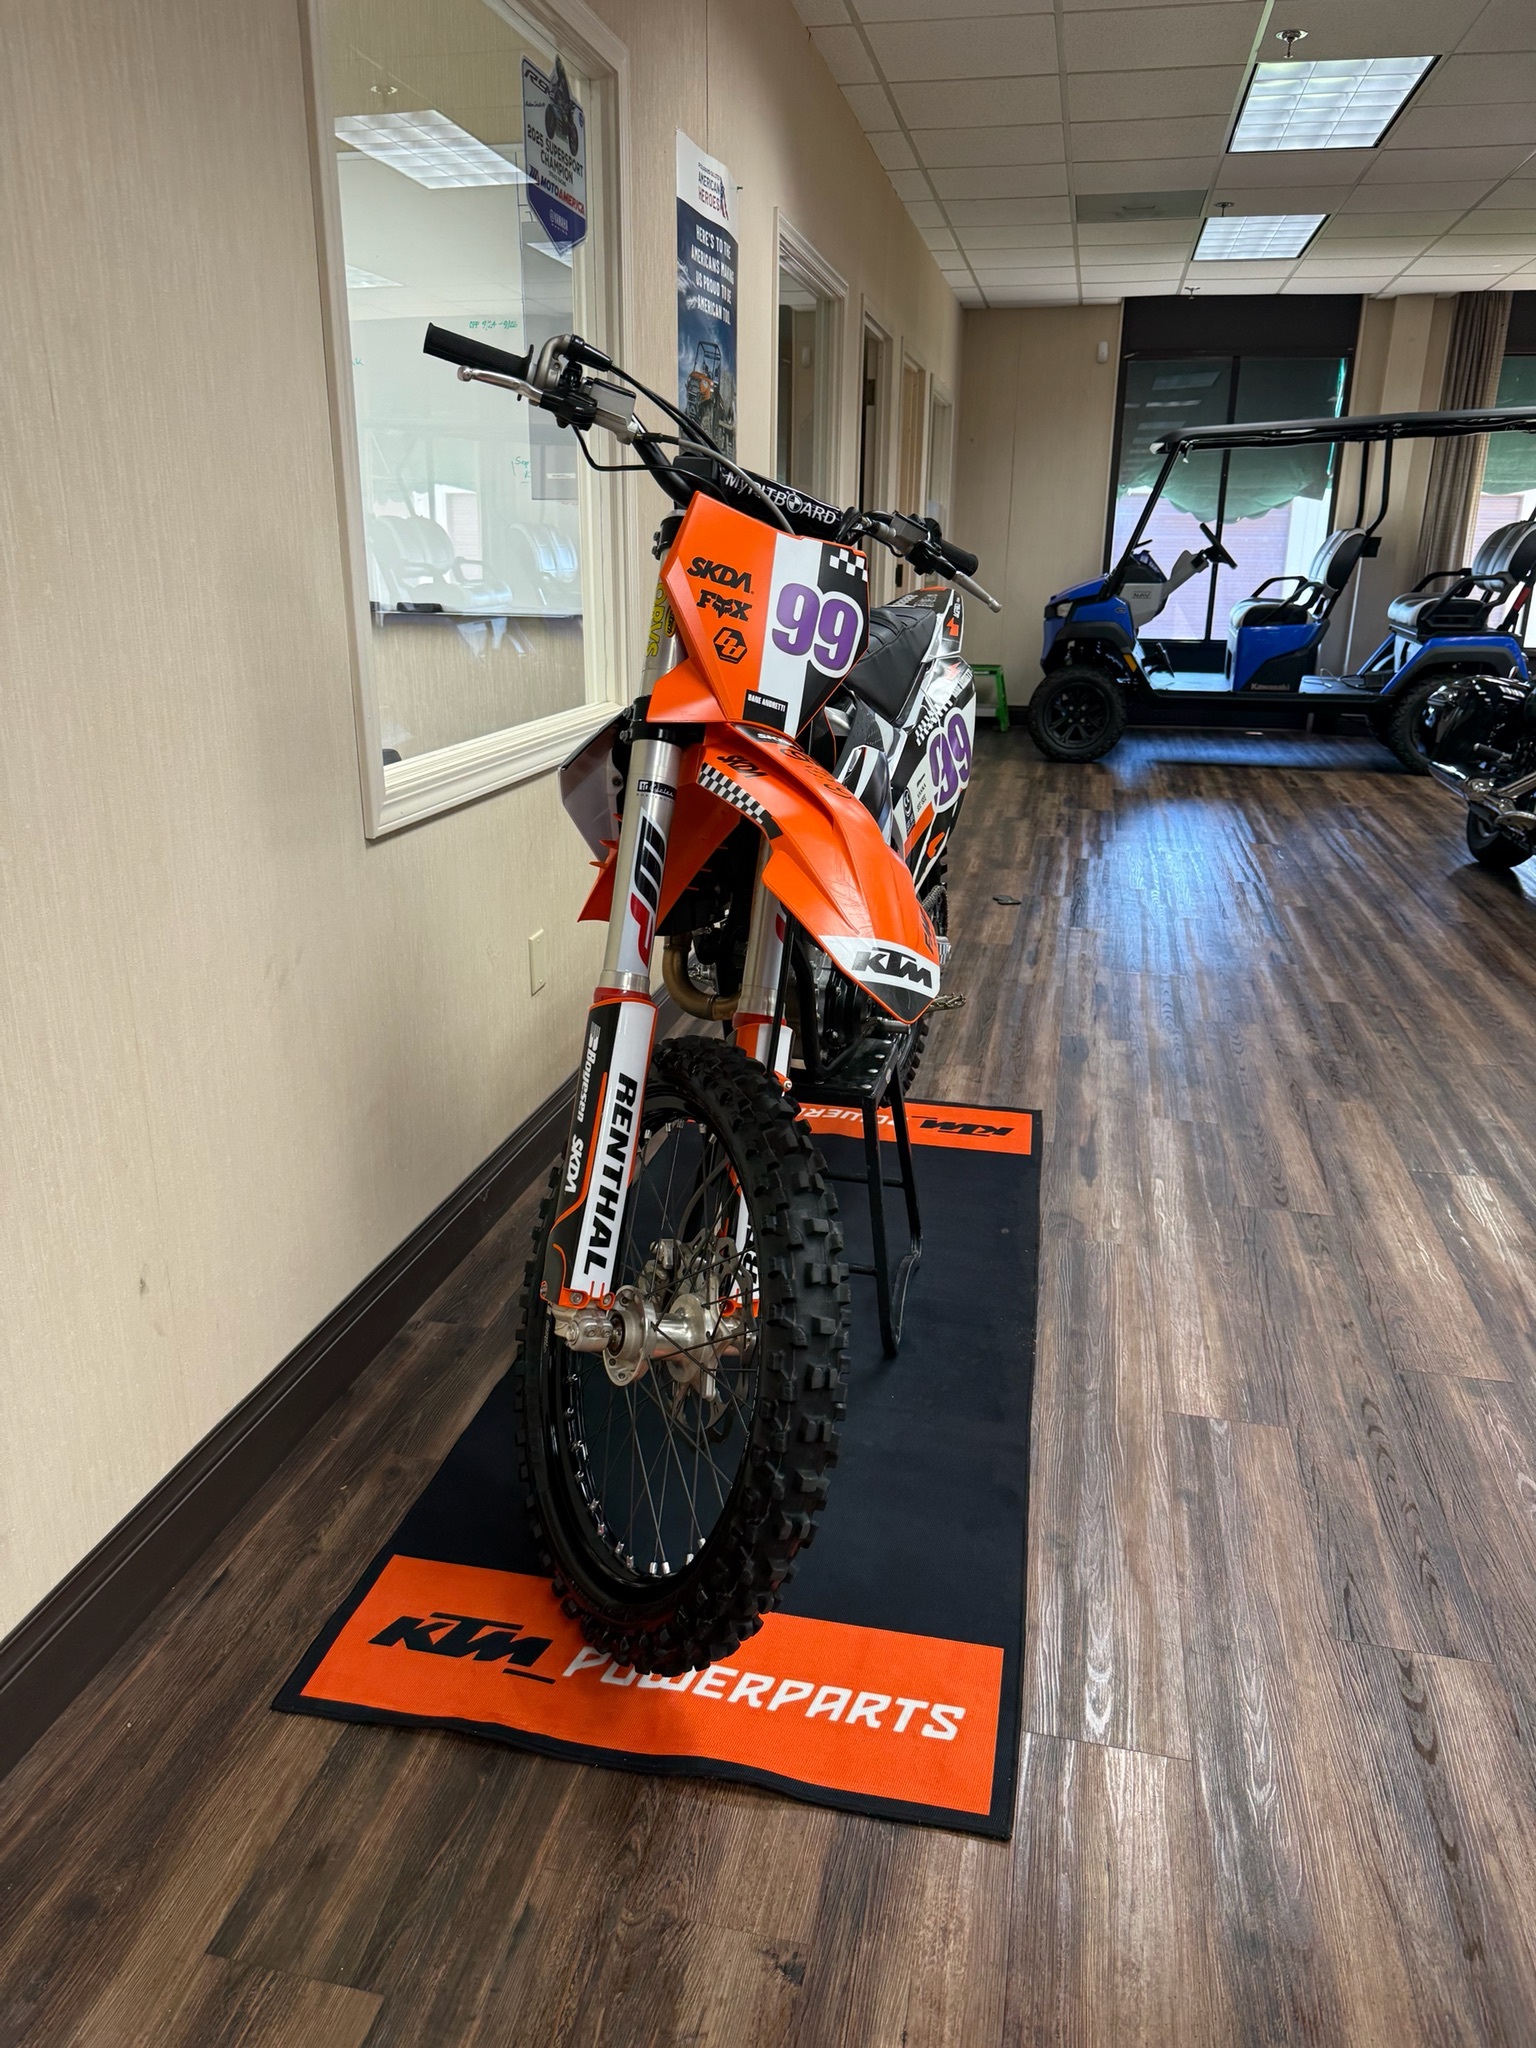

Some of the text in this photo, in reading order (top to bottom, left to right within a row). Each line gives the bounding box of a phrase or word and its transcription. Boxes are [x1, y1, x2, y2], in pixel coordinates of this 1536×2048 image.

[527, 124, 584, 178] 2025 SUPERSPORT
[540, 149, 574, 185] CHAMPION
[540, 175, 585, 216] MOTOAMERICA
[698, 171, 721, 196] AMERICAN
[698, 185, 720, 211] HEROES
[691, 243, 720, 275] AMERICANS
[695, 223, 732, 261] HERE'S TO THE
[695, 269, 703, 288] US
[702, 274, 720, 297] PROUD
[697, 294, 723, 320] AMERICAN
[687, 556, 754, 594] SKDA
[772, 583, 859, 671] 99
[928, 712, 972, 808] 99
[851, 945, 934, 990] KTM
[919, 1118, 1015, 1137] KTM
[564, 1134, 584, 1193] SKDA
[583, 1071, 638, 1276] RENTHAL
[368, 1611, 554, 1669] KTM
